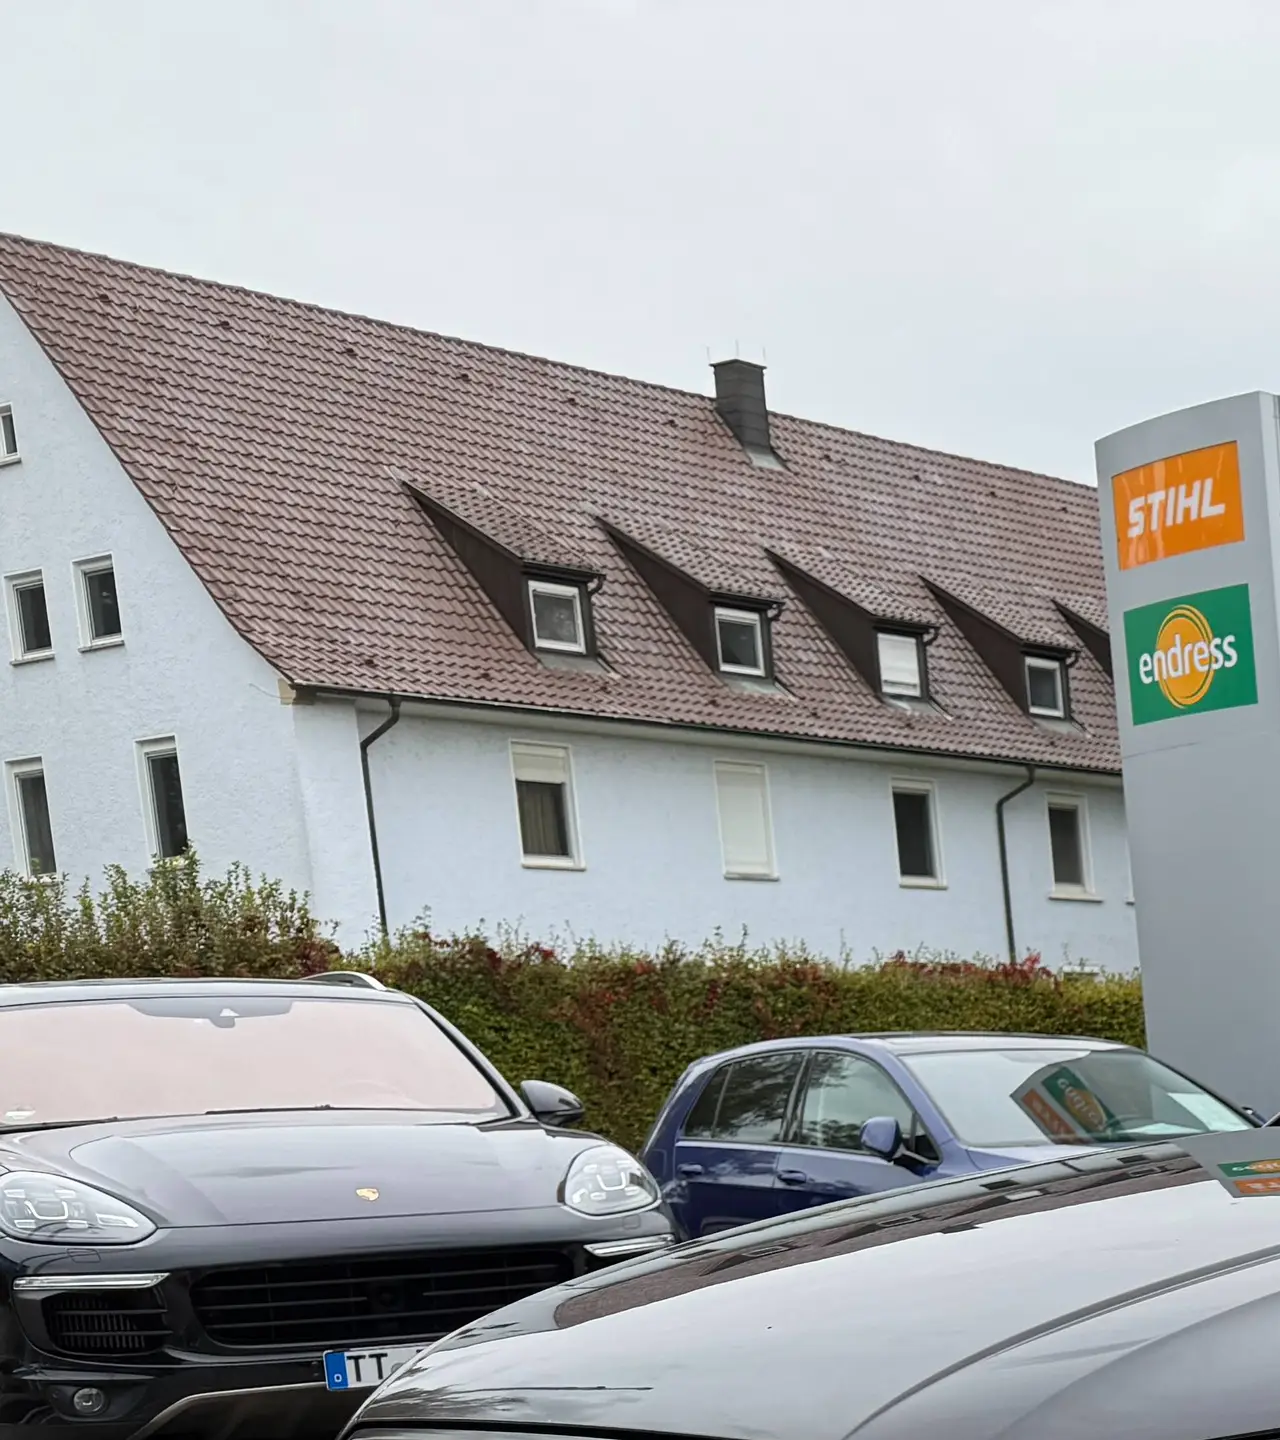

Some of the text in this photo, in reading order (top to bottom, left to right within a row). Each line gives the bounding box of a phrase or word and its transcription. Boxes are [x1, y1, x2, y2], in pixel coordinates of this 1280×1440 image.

[1127, 478, 1225, 538] STIHL
[1139, 633, 1238, 684] endress
[347, 1352, 388, 1382] TT
